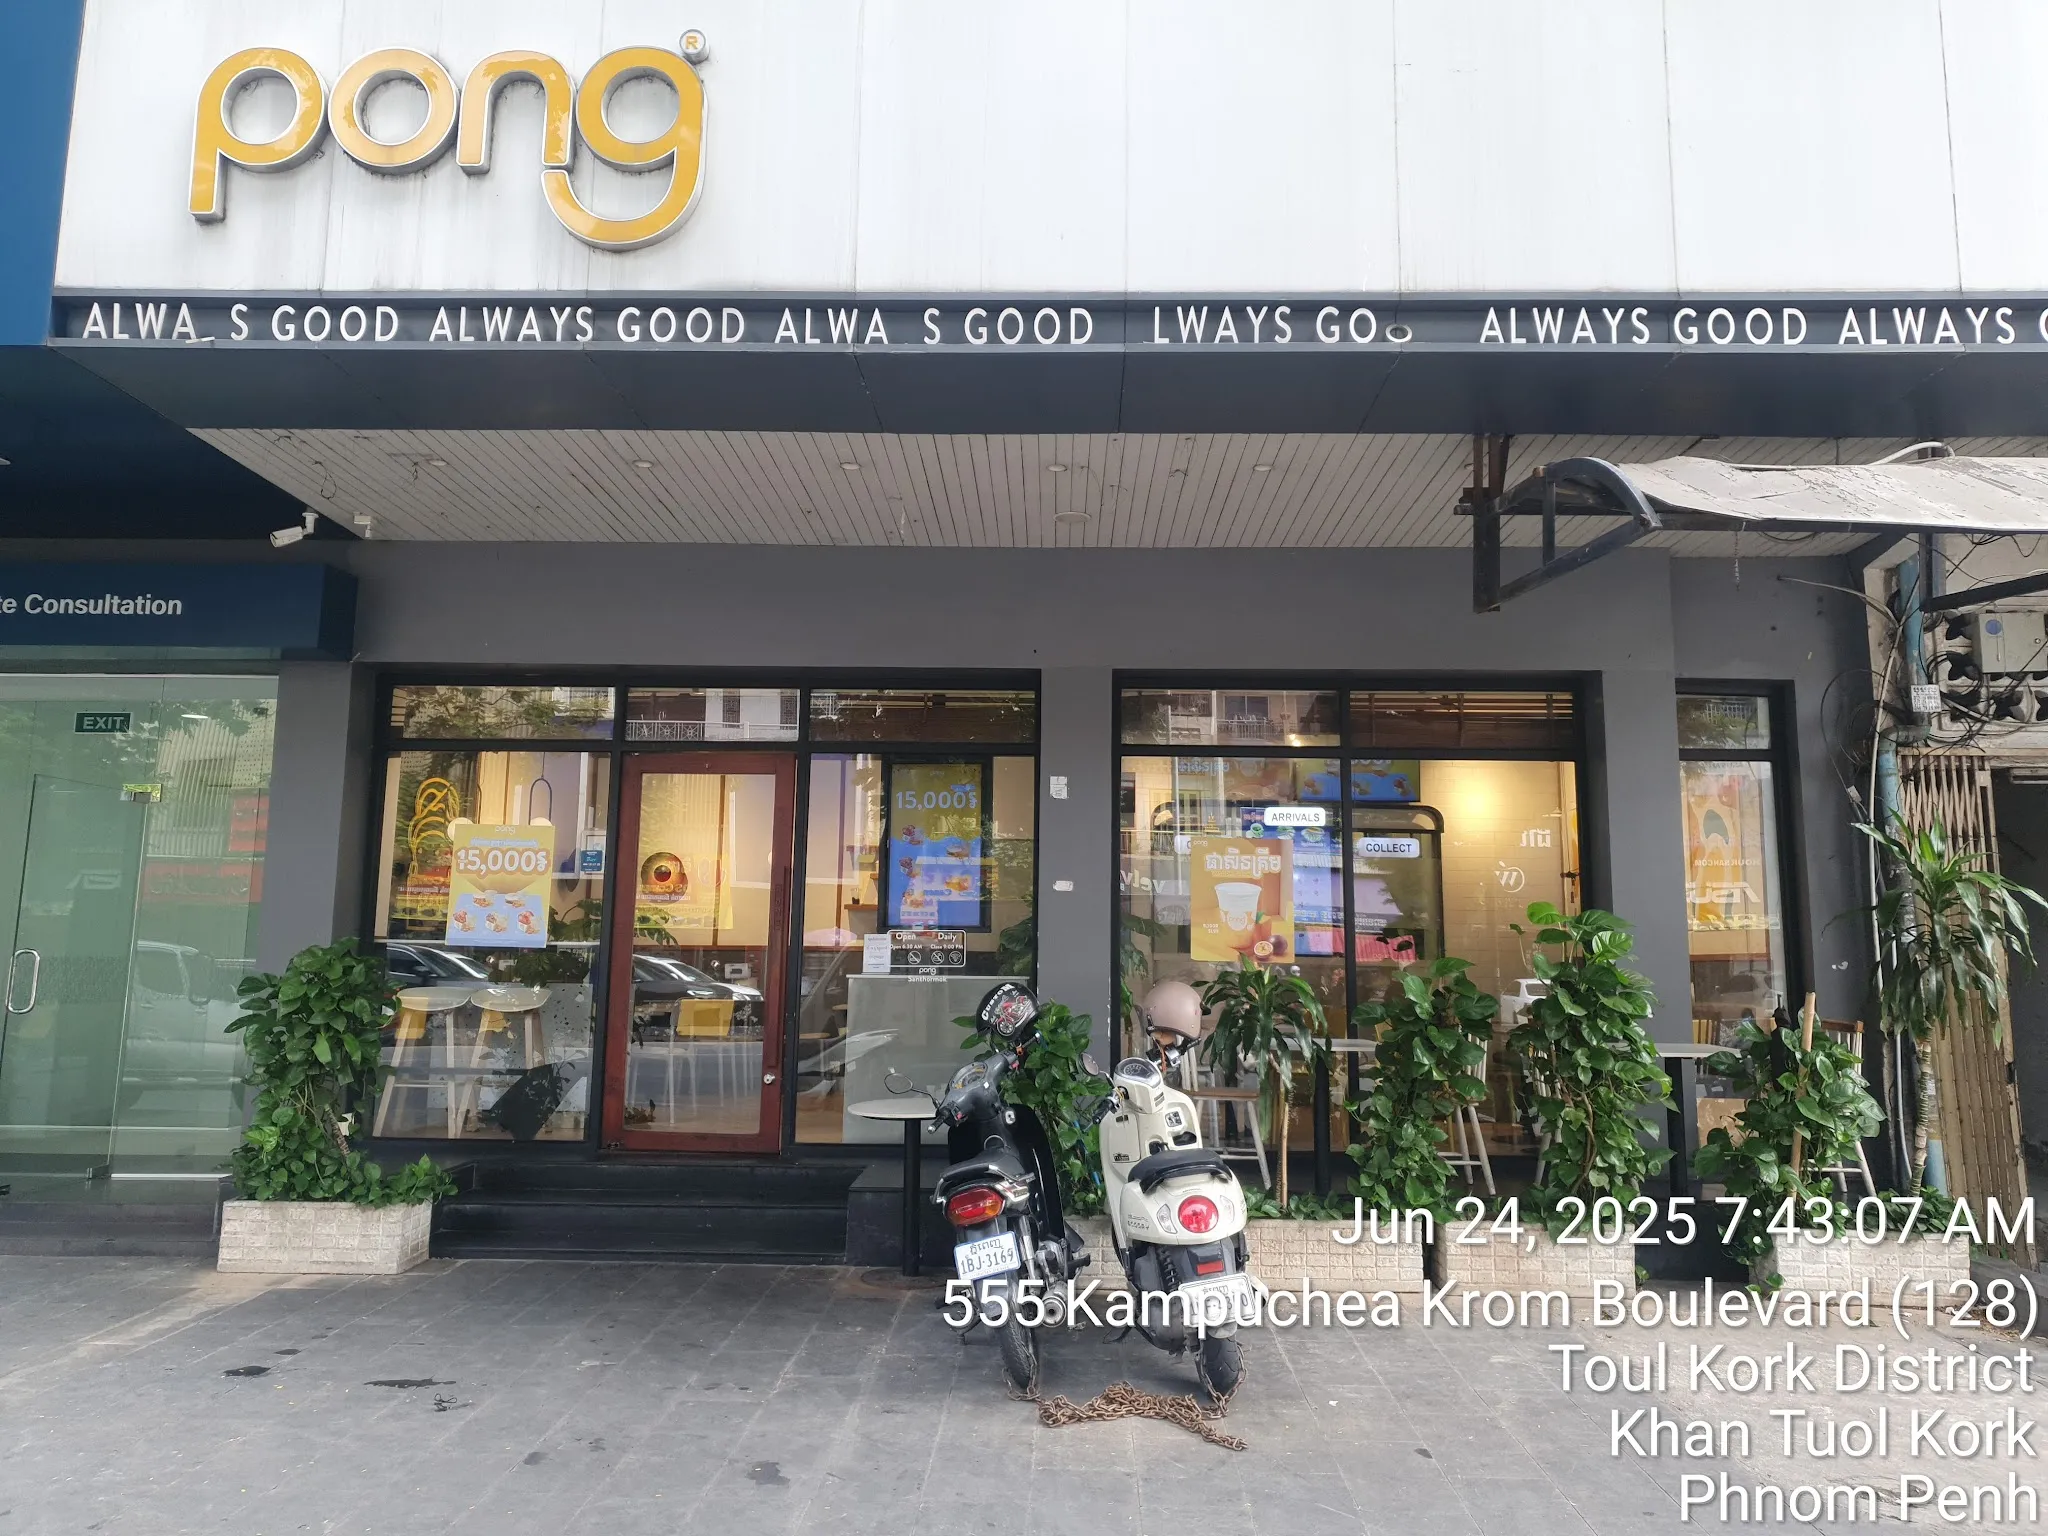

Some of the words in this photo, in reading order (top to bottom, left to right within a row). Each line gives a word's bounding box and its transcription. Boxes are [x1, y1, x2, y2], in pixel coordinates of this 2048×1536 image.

[188, 45, 708, 250] pong
[271, 304, 399, 343] GOOD
[429, 306, 593, 343] ALWAYS
[617, 307, 745, 344] GOOD
[964, 307, 1093, 345] GOOD
[1480, 306, 1651, 345] ALWAYS
[1673, 307, 1807, 345] GOOD
[1838, 307, 2016, 345] ALWAYS
[24, 592, 182, 615] Consultation
[83, 716, 125, 729] EXIT
[1271, 812, 1320, 823] ARRIVALS
[1365, 842, 1412, 853] COLLECT
[895, 932, 917, 943] Open
[938, 932, 957, 943] Daily
[919, 967, 937, 976] pong
